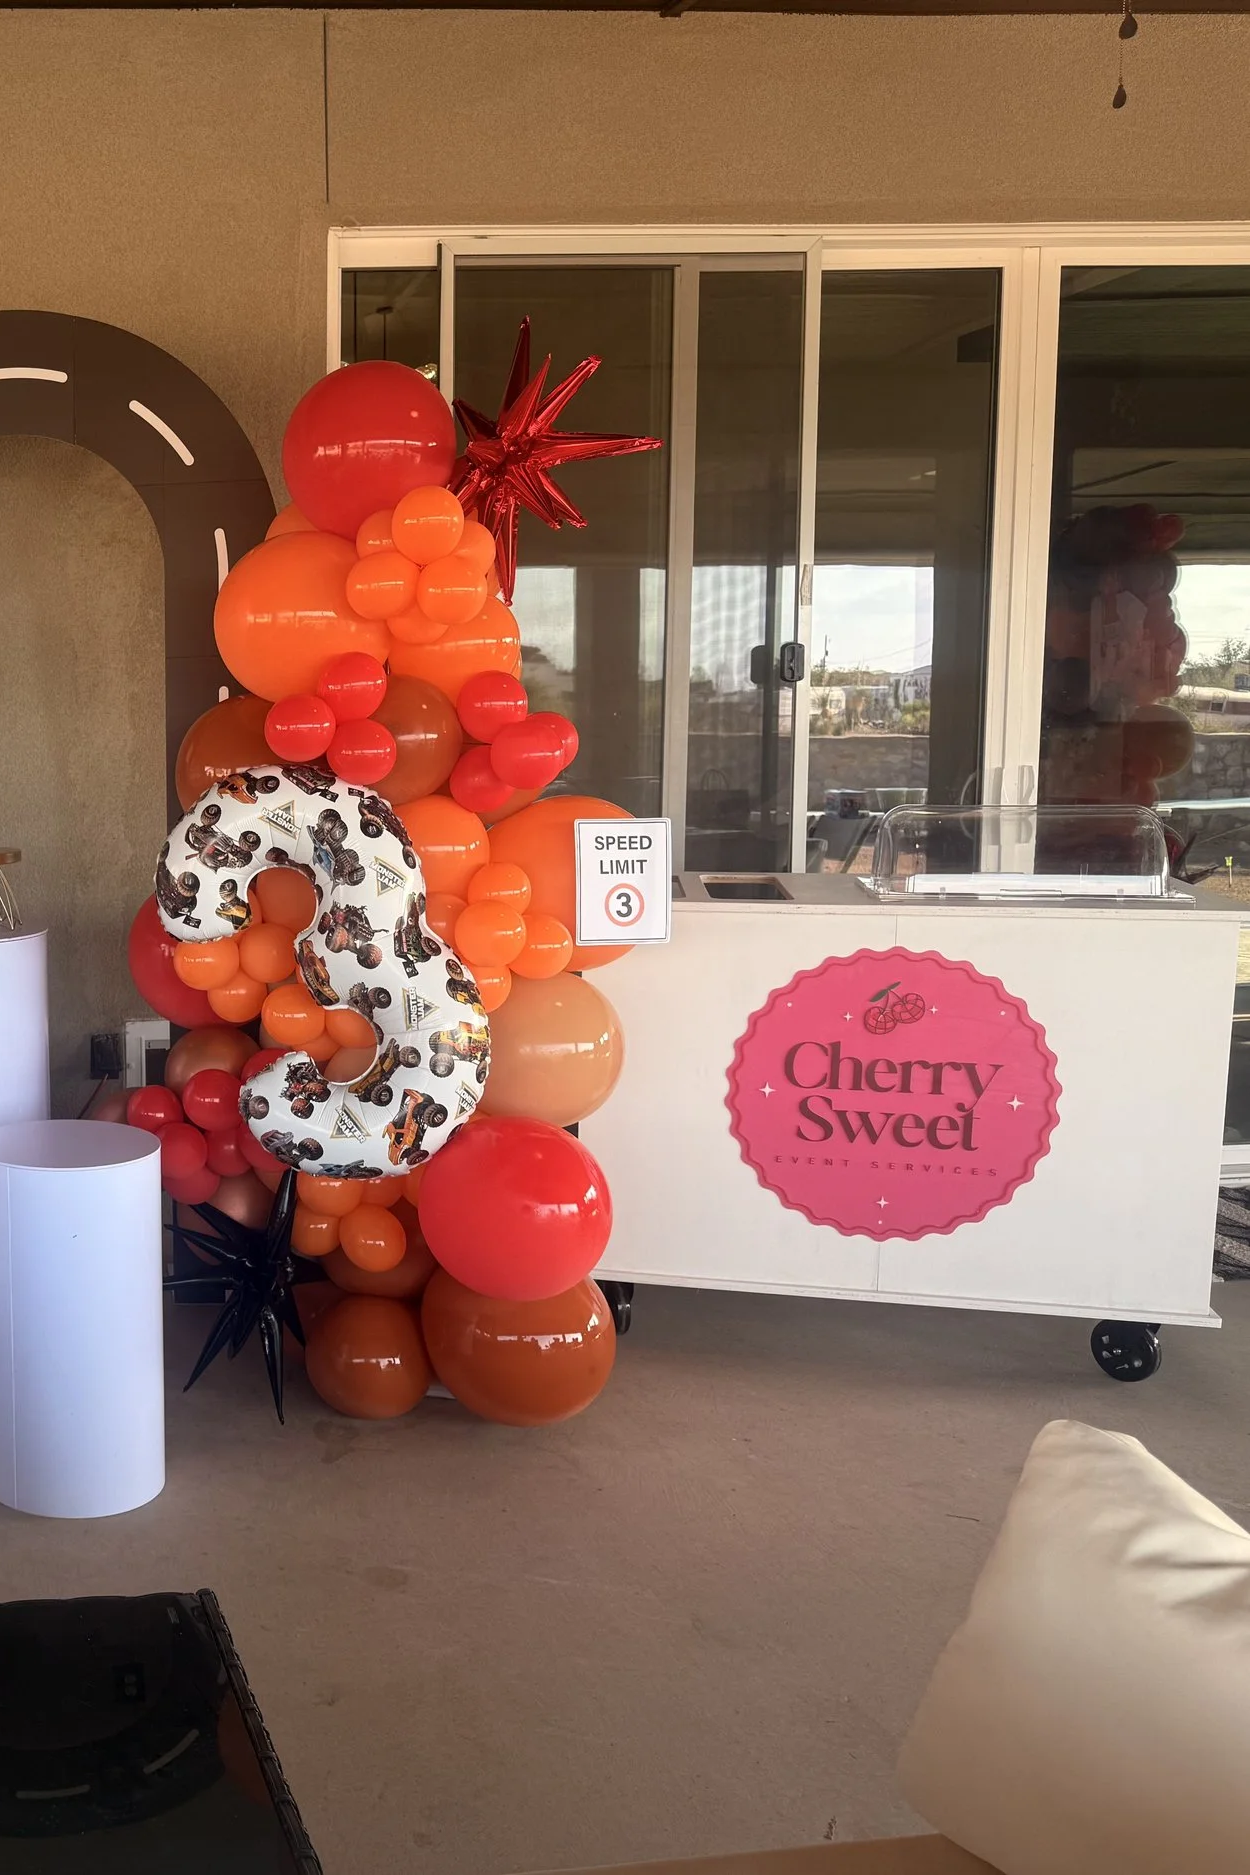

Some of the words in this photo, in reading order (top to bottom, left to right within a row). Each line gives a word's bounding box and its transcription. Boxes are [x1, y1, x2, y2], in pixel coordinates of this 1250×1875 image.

[261, 806, 301, 835] MONSTER
[275, 808, 294, 823] JAM
[594, 835, 653, 851] SPEED
[369, 861, 406, 889] MONSTER
[599, 859, 648, 875] LIMIT
[377, 875, 395, 890] JAM
[615, 892, 633, 918] 3
[409, 986, 419, 1031] MONSTER
[417, 998, 425, 1019] JAM
[783, 1040, 1005, 1112] Cherry
[335, 1105, 366, 1144] MONSTER
[337, 1117, 353, 1138] JAM
[796, 1094, 981, 1152] Sweet
[773, 1154, 851, 1168] EVENT
[869, 1160, 999, 1178] SERVICES
